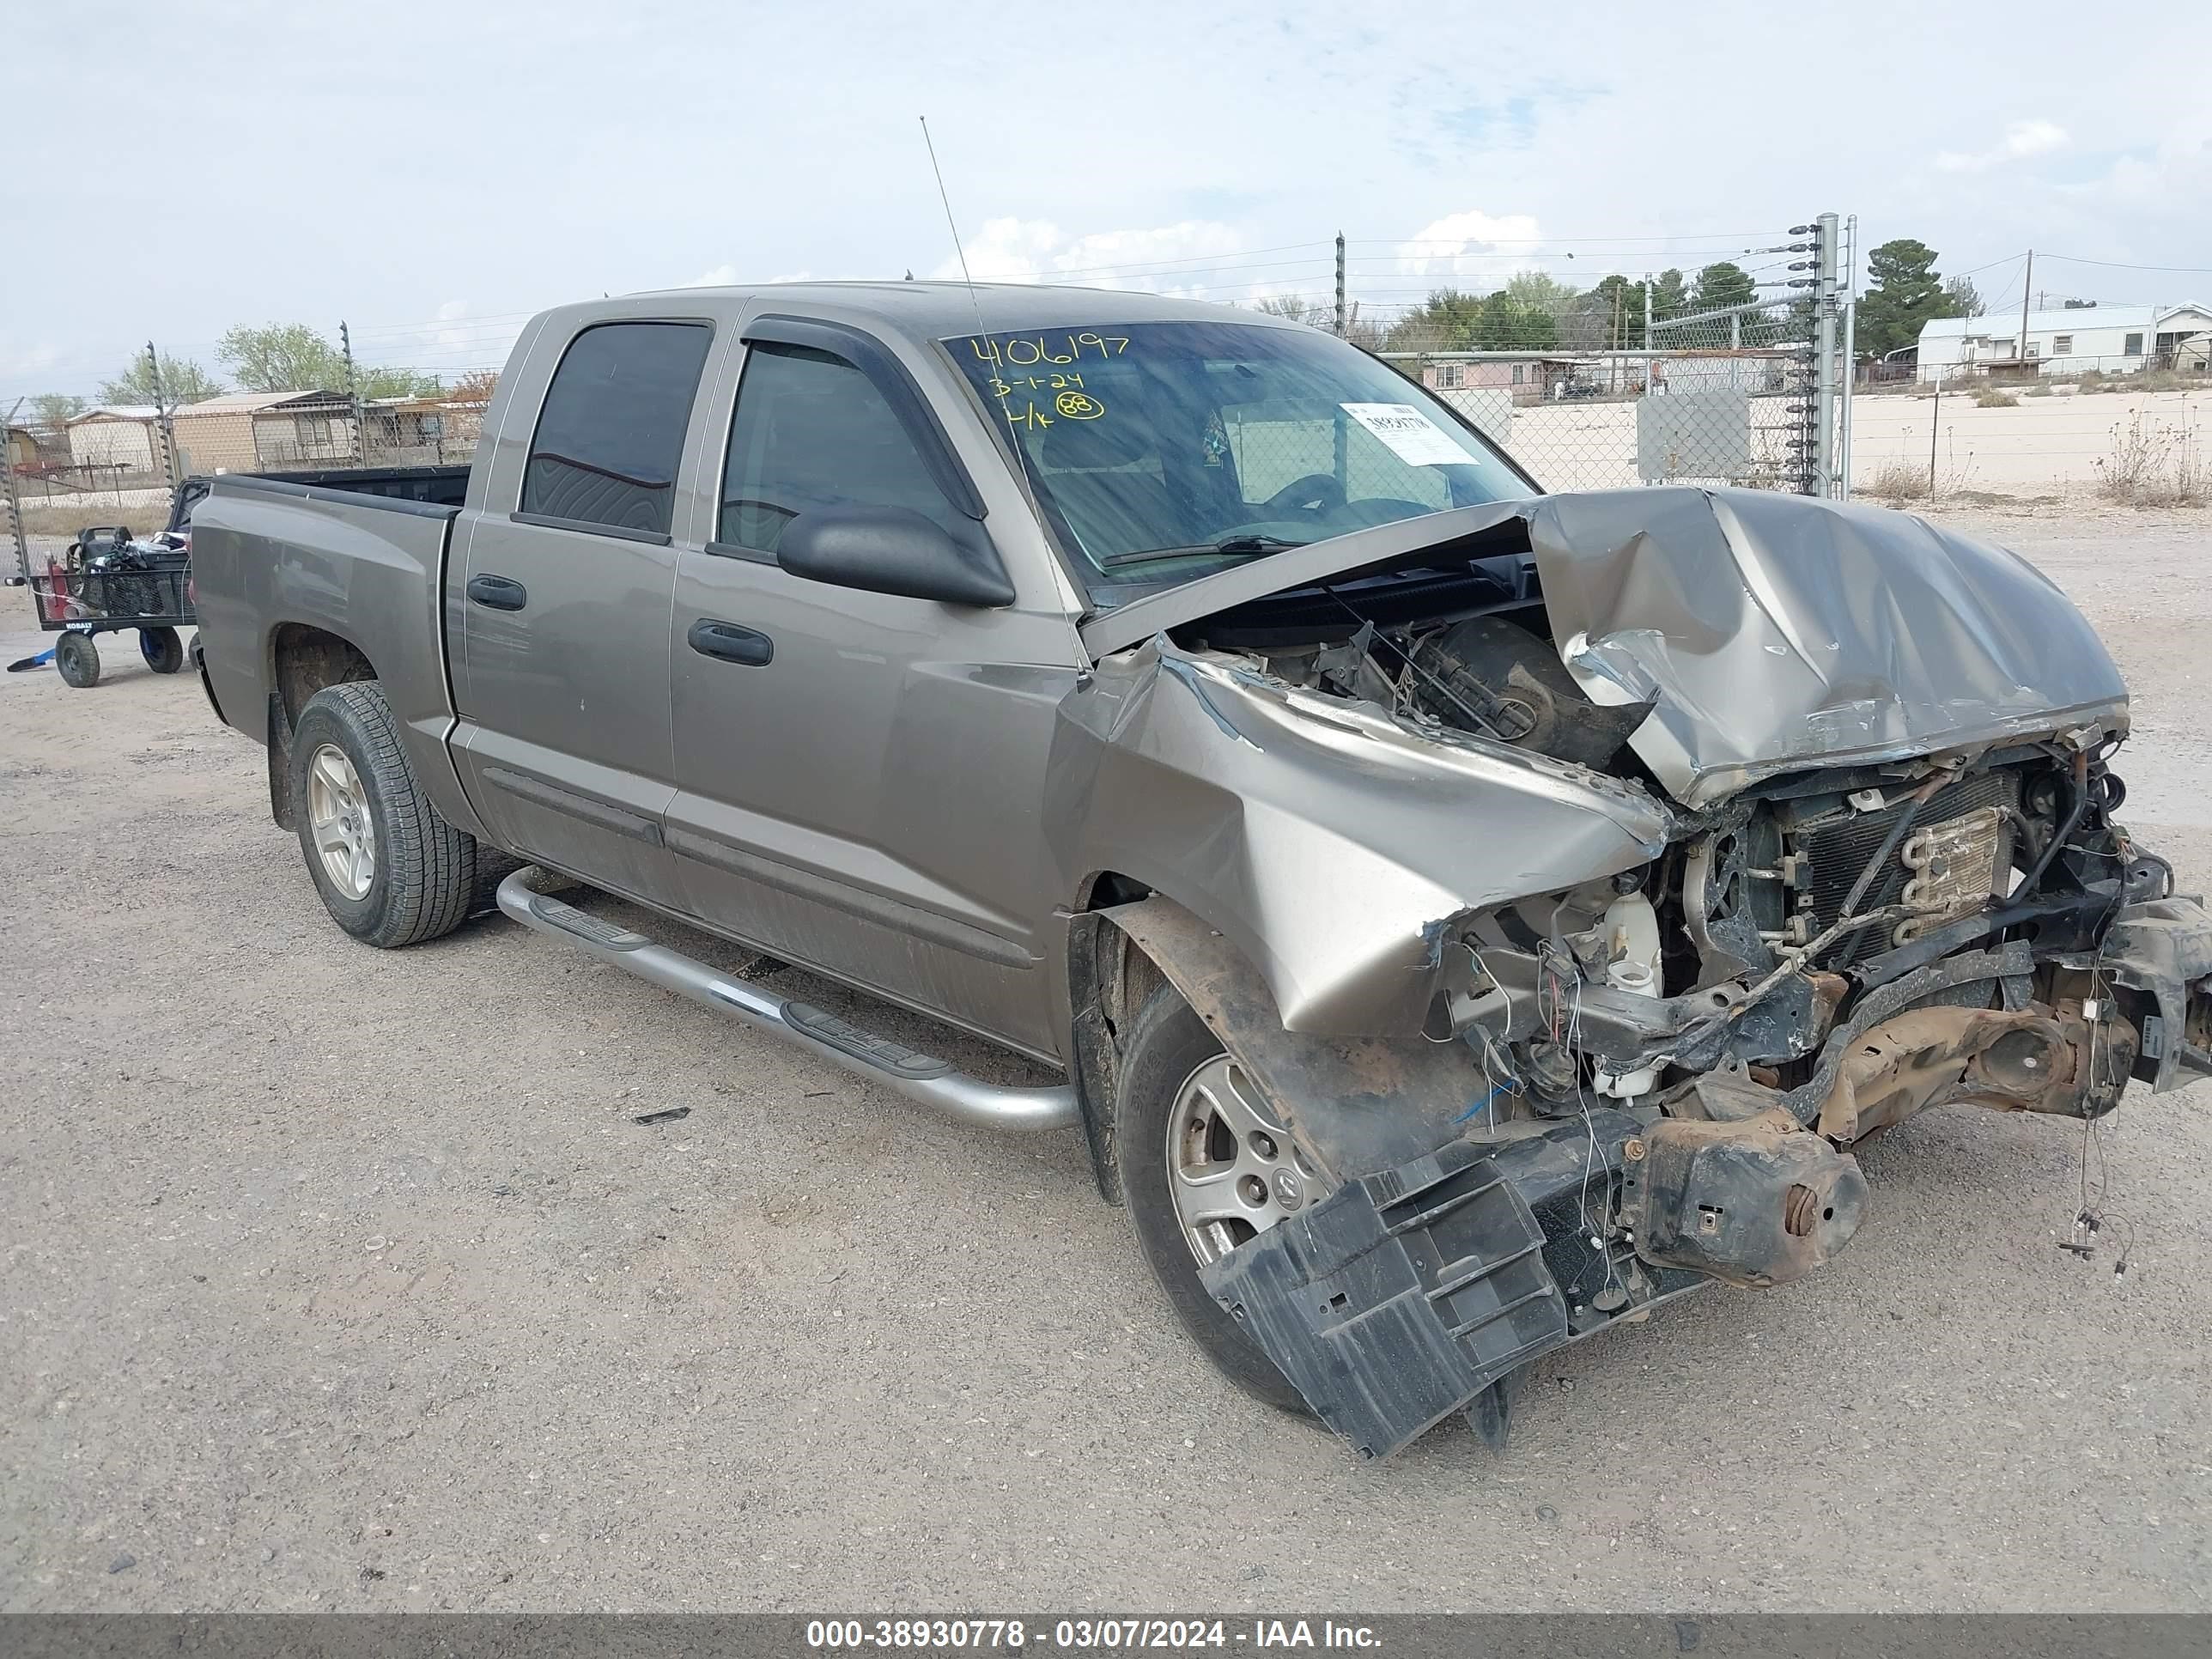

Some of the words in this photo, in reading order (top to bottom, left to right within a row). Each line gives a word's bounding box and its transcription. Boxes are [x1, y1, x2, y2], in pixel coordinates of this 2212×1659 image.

[971, 332, 1129, 367] 406197
[989, 373, 1085, 397] 3-1-24
[1060, 395, 1092, 414] 88
